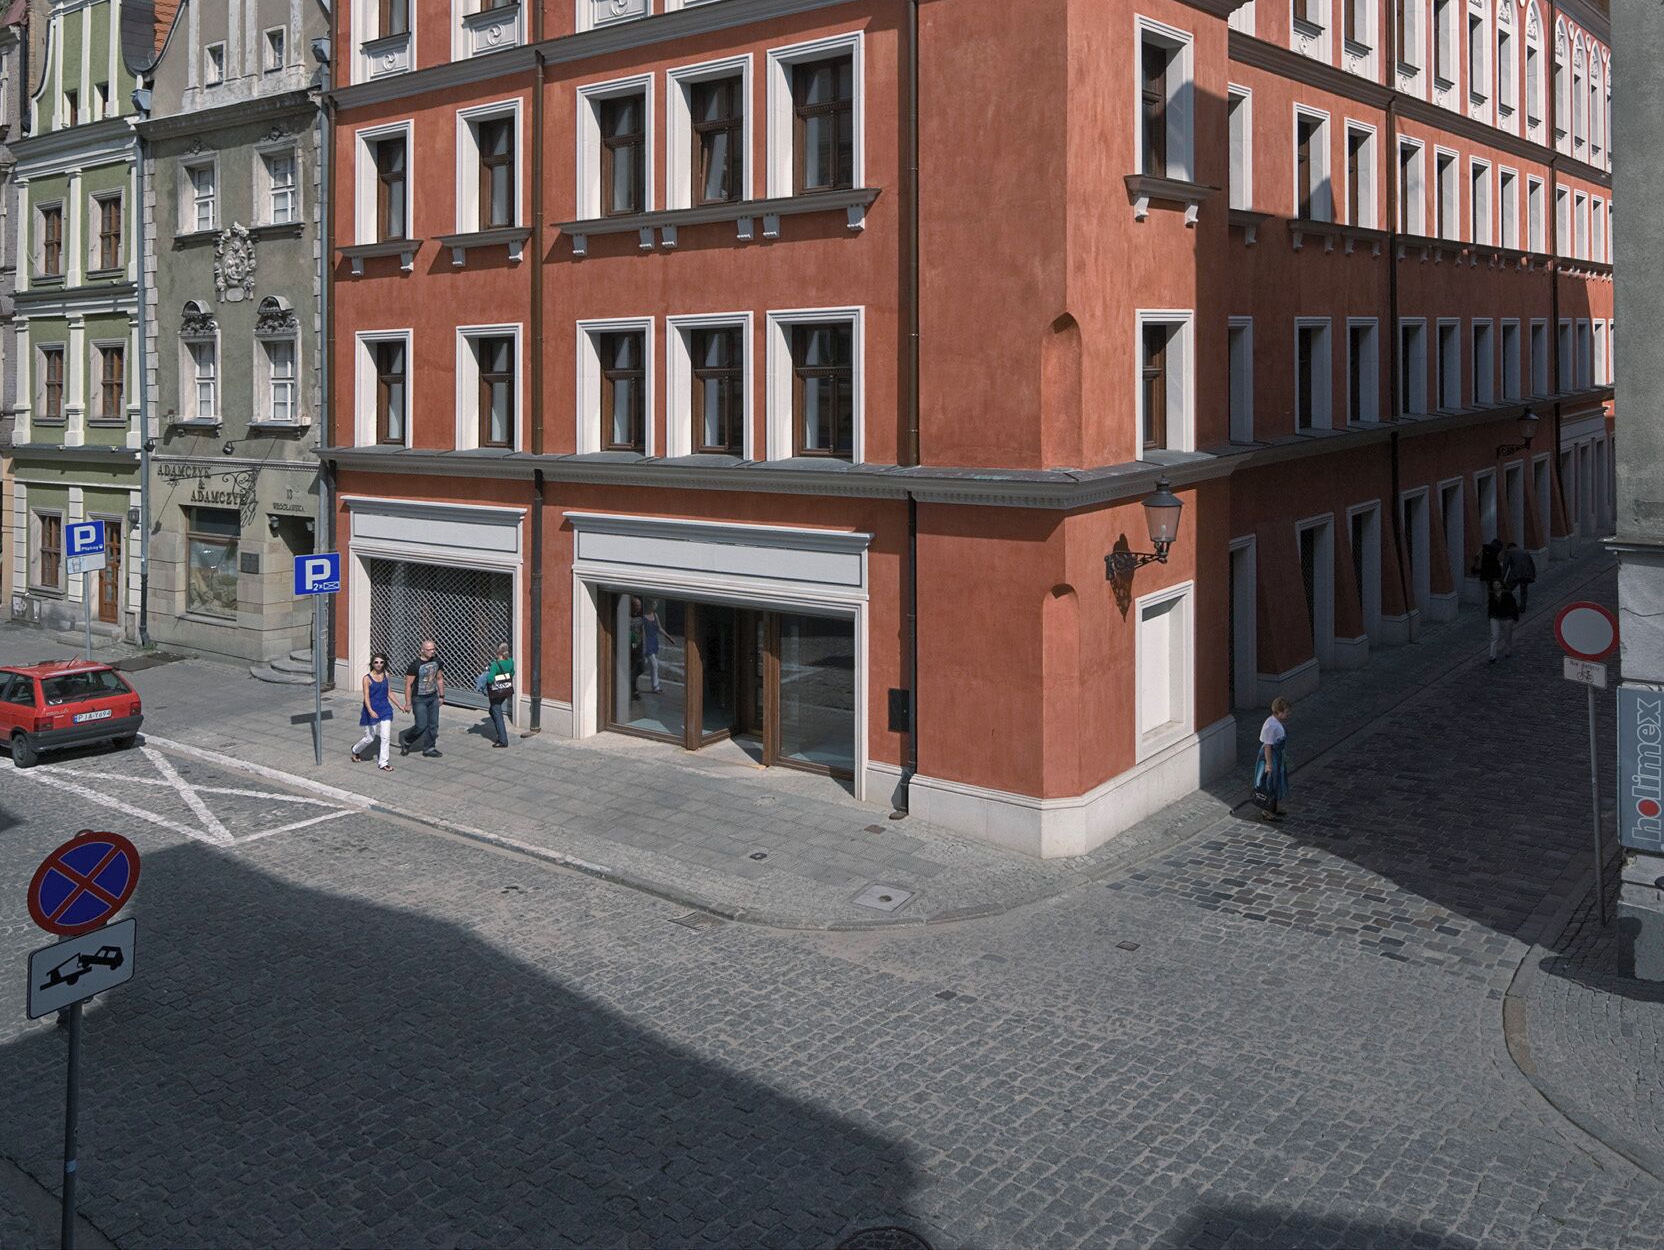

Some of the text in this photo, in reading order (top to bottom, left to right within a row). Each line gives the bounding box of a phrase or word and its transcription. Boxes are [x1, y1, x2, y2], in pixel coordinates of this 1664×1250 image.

[157, 464, 211, 478] ADAMCZYK
[198, 478, 205, 489] &
[190, 490, 247, 505] ADAMCZYK
[74, 525, 96, 552] P
[305, 559, 331, 590] P
[1632, 698, 1662, 842] holimex
